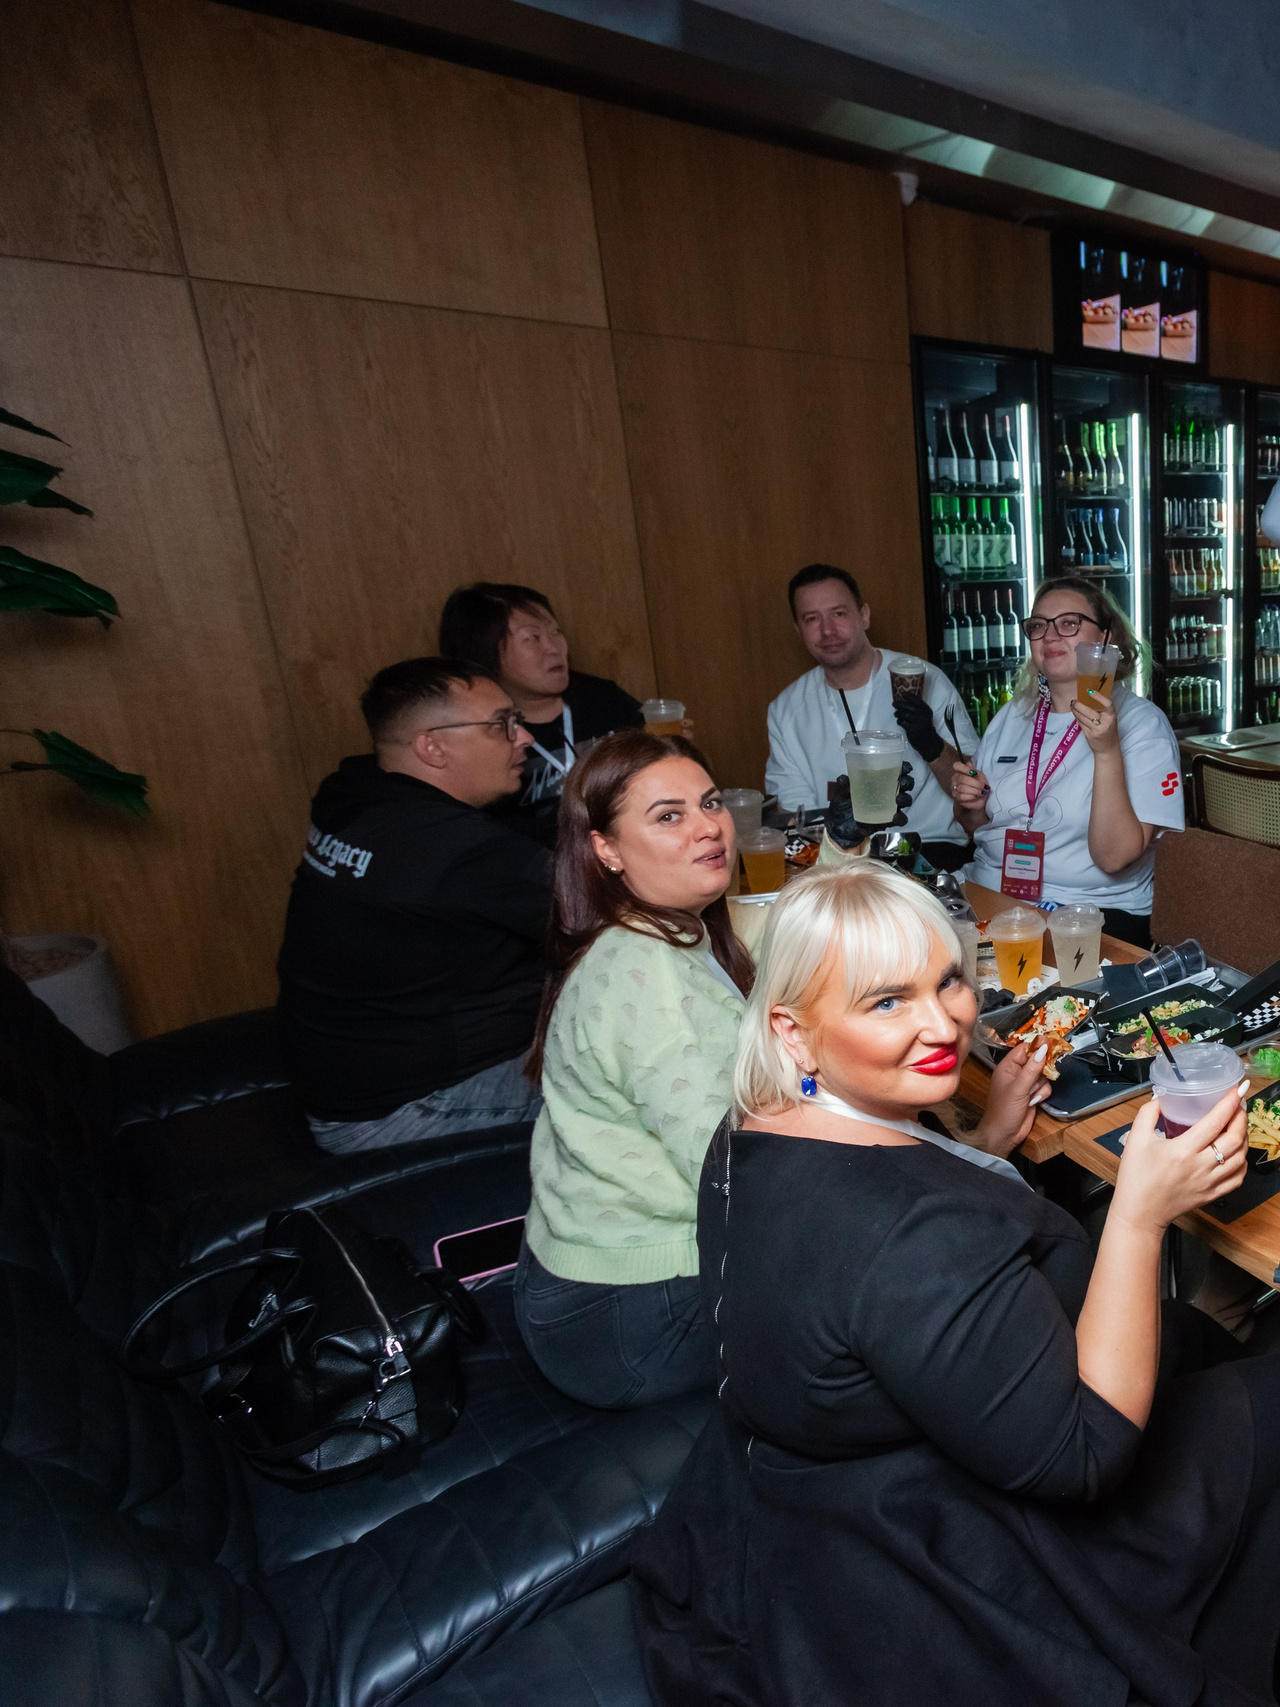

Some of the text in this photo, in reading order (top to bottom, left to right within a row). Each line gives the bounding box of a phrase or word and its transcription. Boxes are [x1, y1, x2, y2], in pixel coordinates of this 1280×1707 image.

[1063, 719, 1080, 746] гастр
[1027, 742, 1039, 784] гастротур
[317, 834, 373, 879] Legacy
